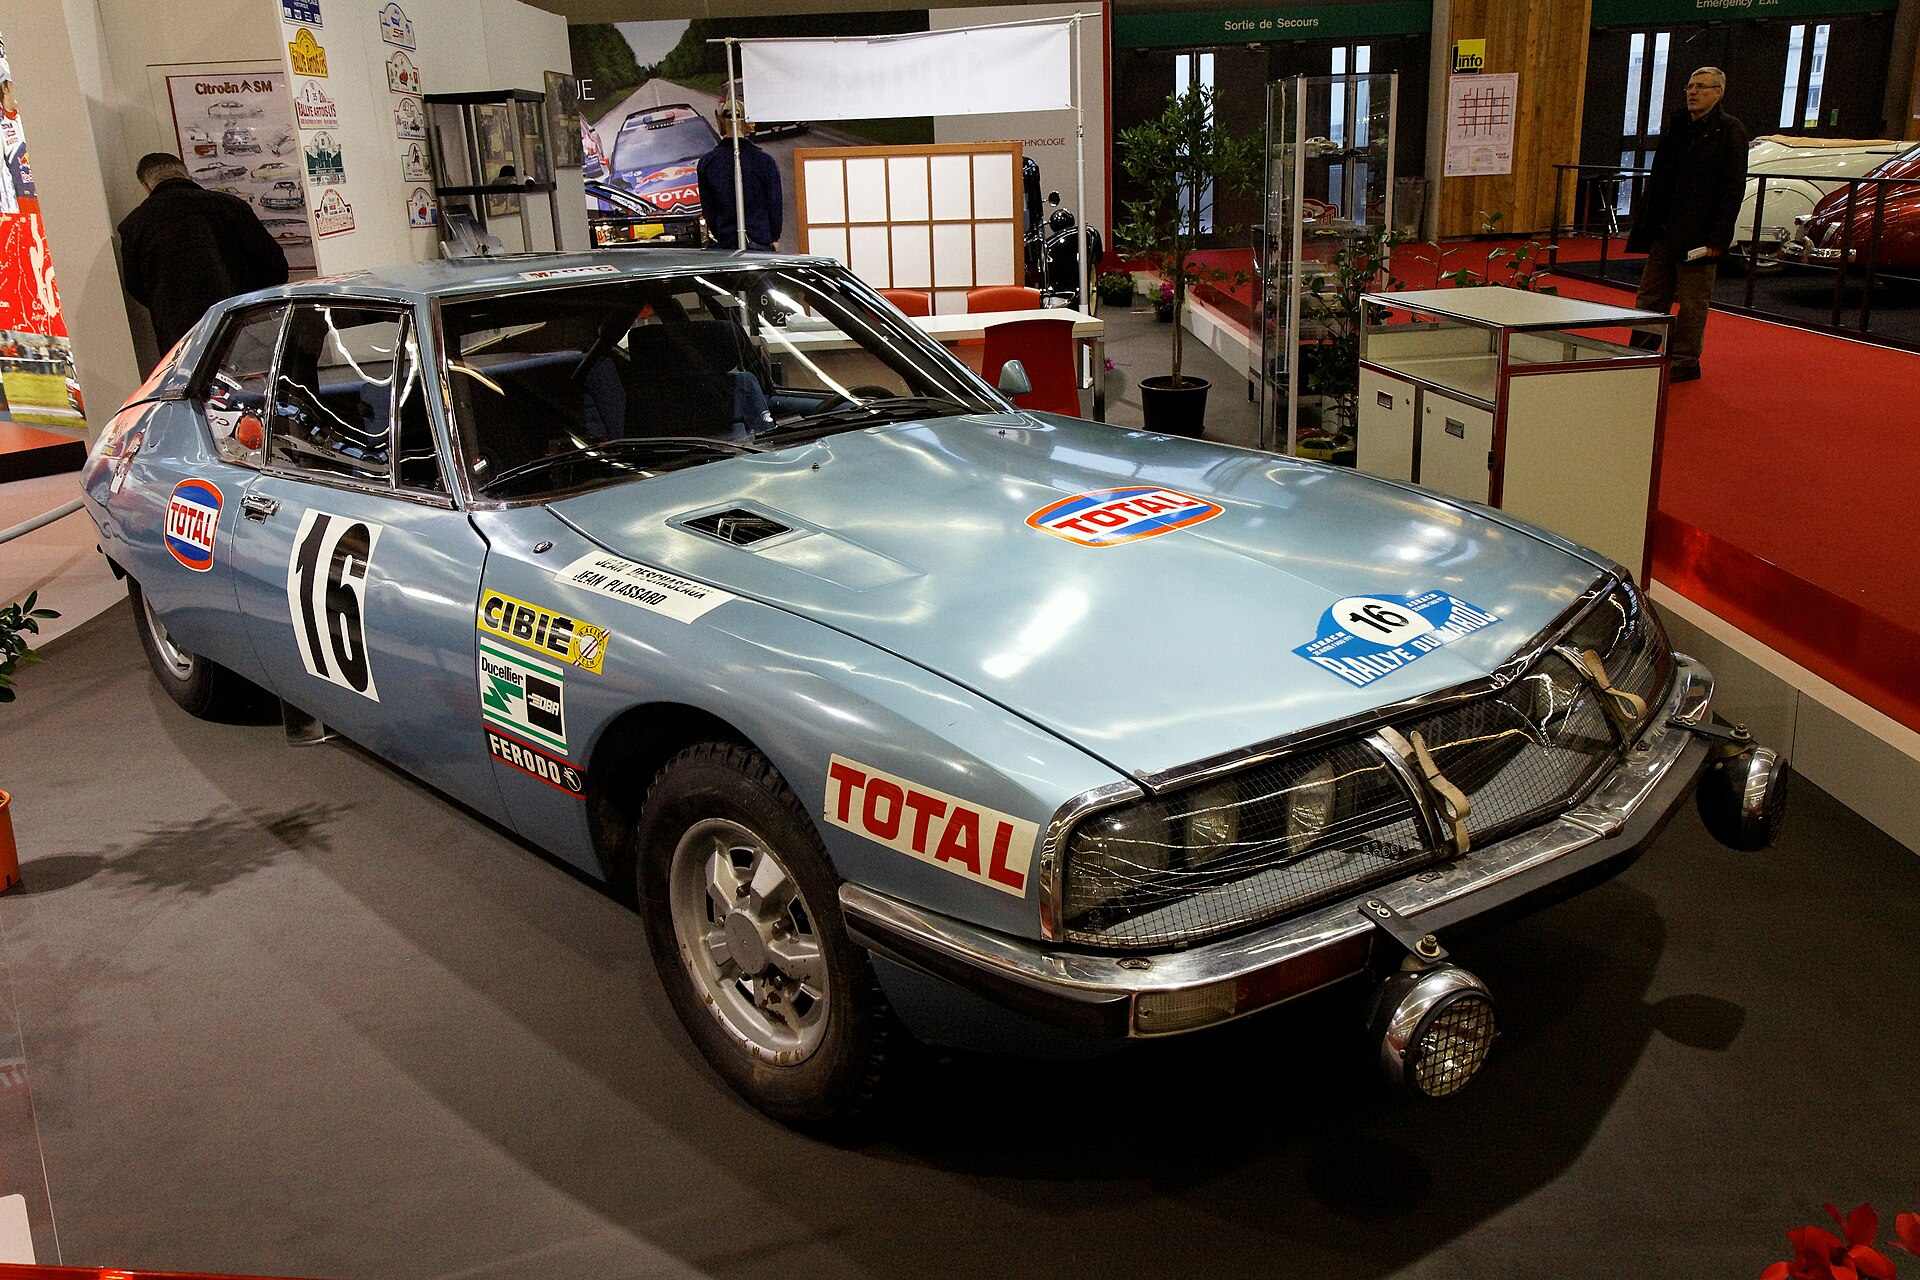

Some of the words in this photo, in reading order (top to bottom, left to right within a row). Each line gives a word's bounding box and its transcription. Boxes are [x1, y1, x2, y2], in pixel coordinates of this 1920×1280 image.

[1224, 19, 1255, 31] Sortie
[1259, 19, 1273, 29] de
[1277, 18, 1319, 28] Secours
[1458, 54, 1483, 68] info
[195, 82, 240, 95] Citroën
[254, 80, 273, 92] SM
[171, 503, 211, 547] TOTAL
[1052, 495, 1198, 534] TOTAL
[595, 557, 632, 573] JEAN
[295, 513, 371, 693] 16
[572, 570, 608, 588] JEAN
[602, 578, 668, 606] PLASSARD
[1349, 604, 1410, 634] 16
[1309, 648, 1416, 686] RALLYE
[1411, 635, 1442, 652] DU
[1436, 596, 1498, 643] MAROC
[481, 656, 524, 686] Ducellier
[539, 696, 560, 716] DBA
[489, 733, 561, 784] FERODO
[830, 762, 1025, 891] TOTAL
